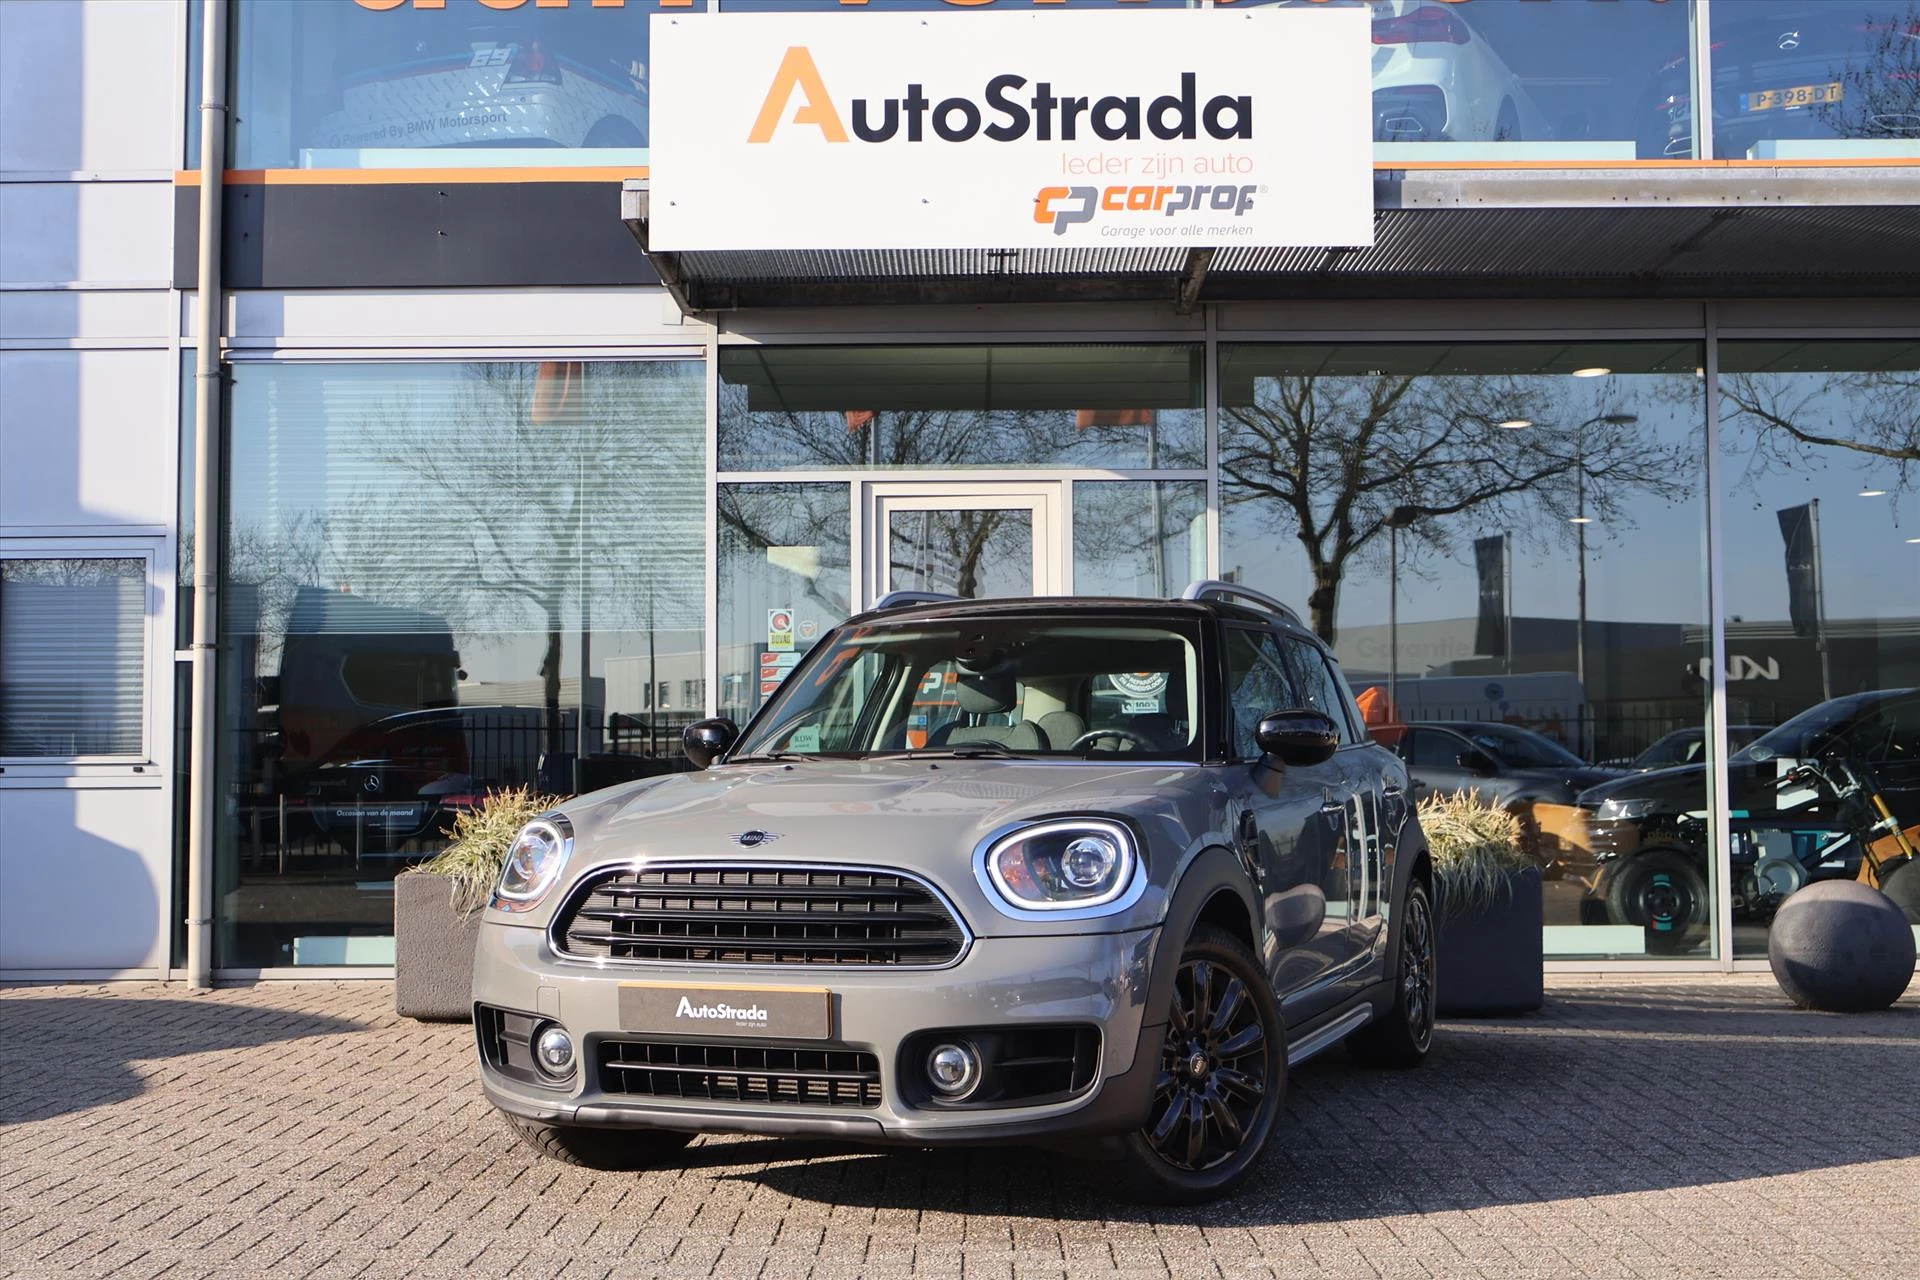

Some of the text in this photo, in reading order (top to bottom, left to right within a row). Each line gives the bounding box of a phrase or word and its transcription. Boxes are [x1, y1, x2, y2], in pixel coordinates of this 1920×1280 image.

[470, 48, 511, 67] 69
[747, 46, 1253, 143] AutoStrada
[1757, 85, 1837, 107] P-398-DT
[342, 112, 508, 146] Powered By BMW Motorsport
[1062, 152, 1254, 180] Ieder zijn auto
[1101, 185, 1258, 216] carprof
[1100, 225, 1253, 238] Garage voor alle merken
[389, 808, 414, 816] maand
[675, 996, 767, 1020] AutoStrada
